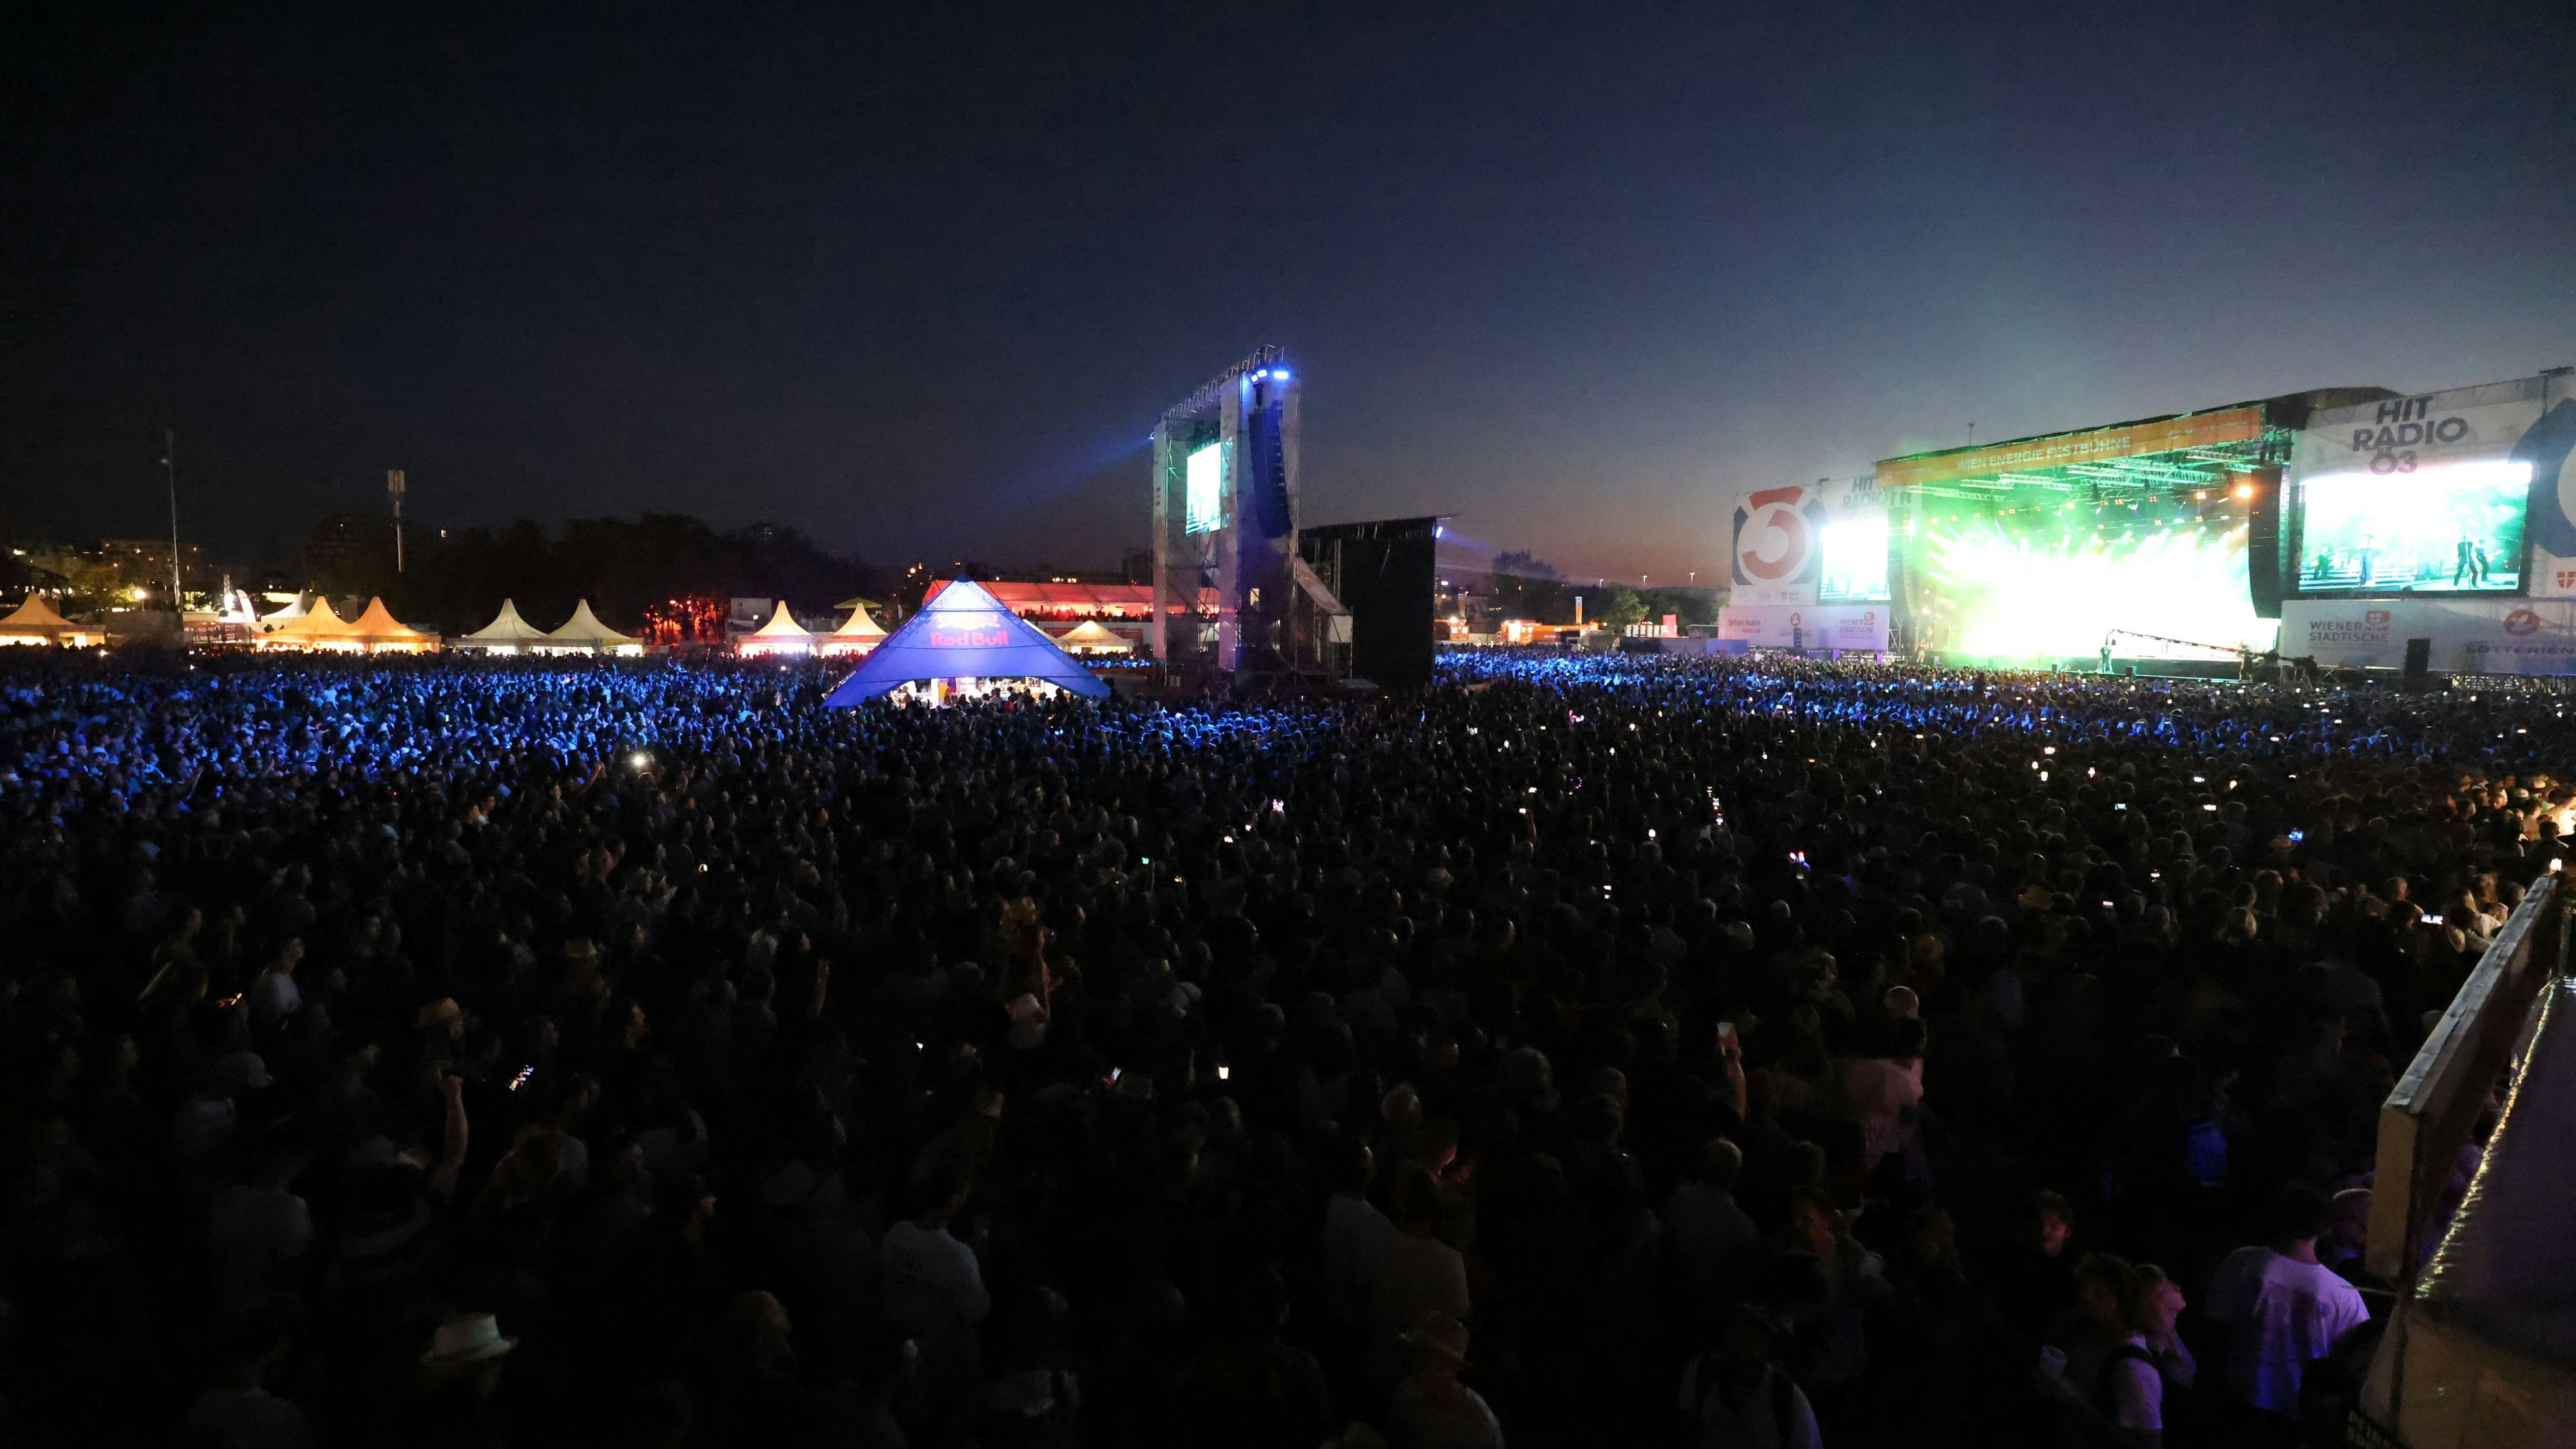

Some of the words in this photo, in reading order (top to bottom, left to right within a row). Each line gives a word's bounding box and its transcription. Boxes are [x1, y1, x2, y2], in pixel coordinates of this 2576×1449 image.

[2376, 395, 2433, 425] HIT
[2353, 417, 2468, 452] RADIO
[1957, 457, 1986, 469] WIEN
[1989, 449, 2043, 467] ENERGIE
[1852, 476, 1875, 493] HIT
[2309, 621, 2362, 631] WIENER
[930, 632, 969, 646] Red
[971, 630, 1009, 645] Bull
